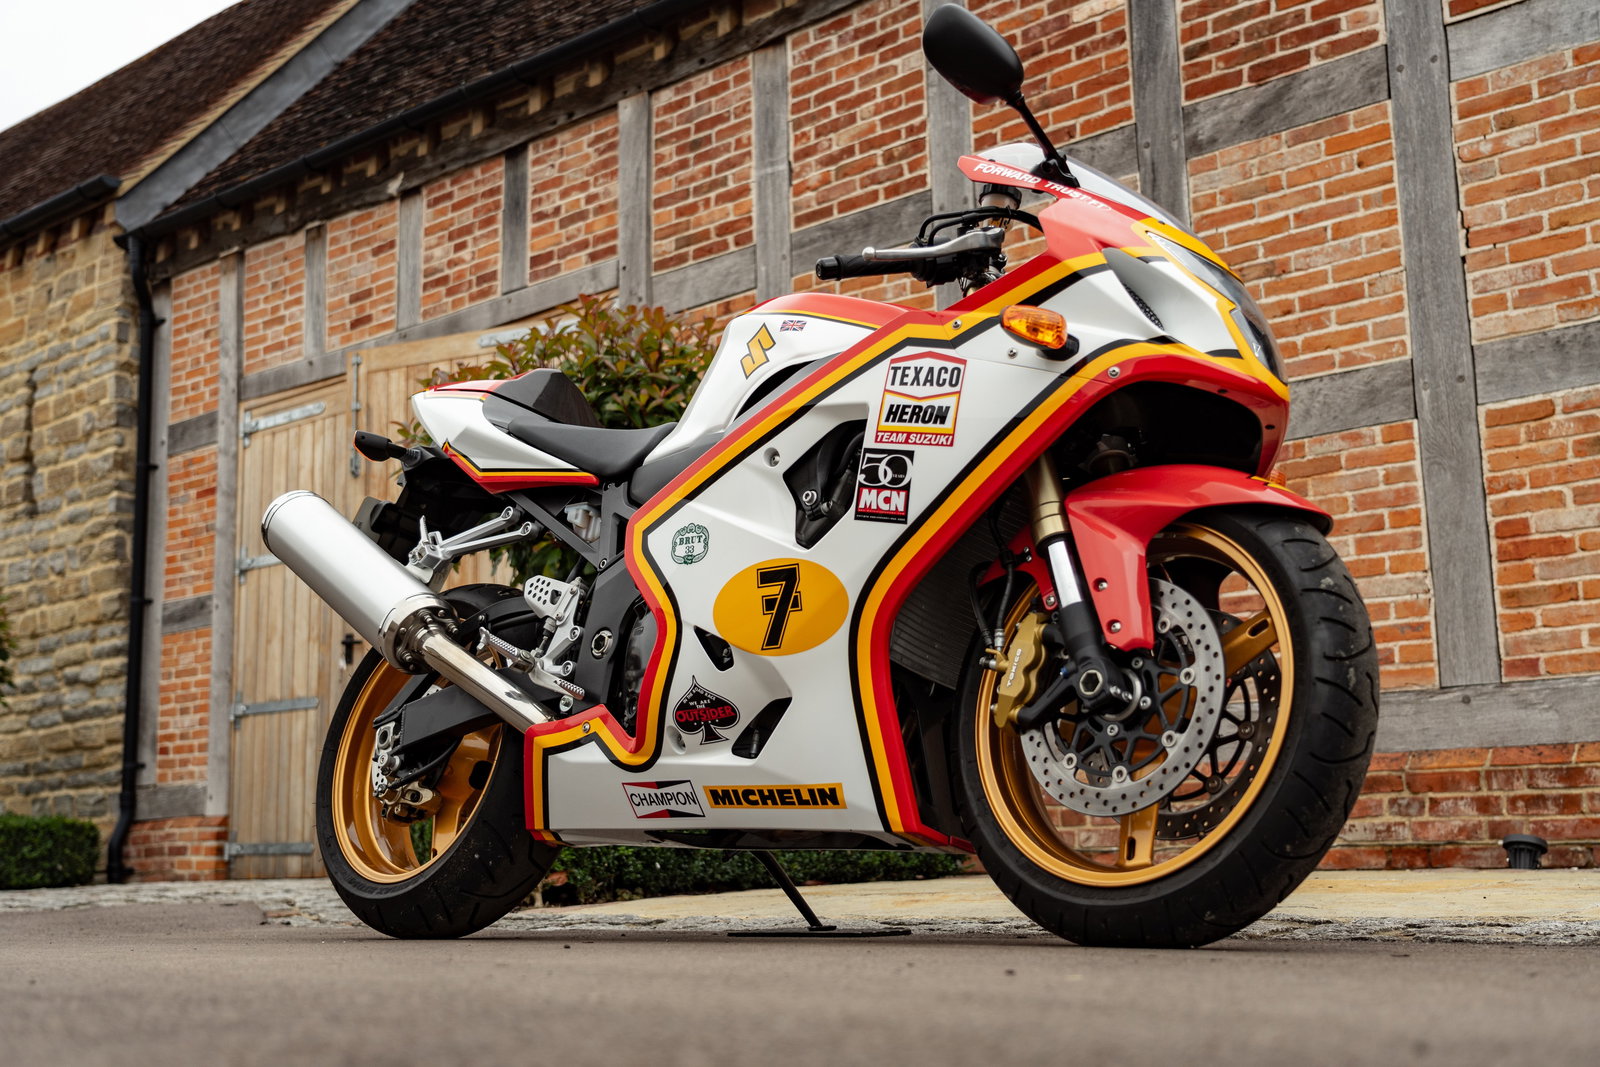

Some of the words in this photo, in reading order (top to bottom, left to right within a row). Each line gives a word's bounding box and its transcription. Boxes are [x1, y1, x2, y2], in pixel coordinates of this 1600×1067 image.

[973, 163, 1041, 184] FORWARD
[1044, 181, 1093, 200] TRUST
[890, 366, 962, 388] TEXACO
[884, 404, 951, 425] HERON
[877, 432, 907, 444] TEAM
[908, 434, 953, 446] SUZUKI
[858, 453, 913, 488] 50
[858, 488, 906, 512] MCN
[679, 535, 703, 546] BRUT
[685, 545, 695, 554] 33
[756, 563, 803, 651] 7
[675, 705, 736, 722] OUTSIDER
[629, 791, 698, 807] CHAMPION
[708, 787, 840, 806] MICHELIN
